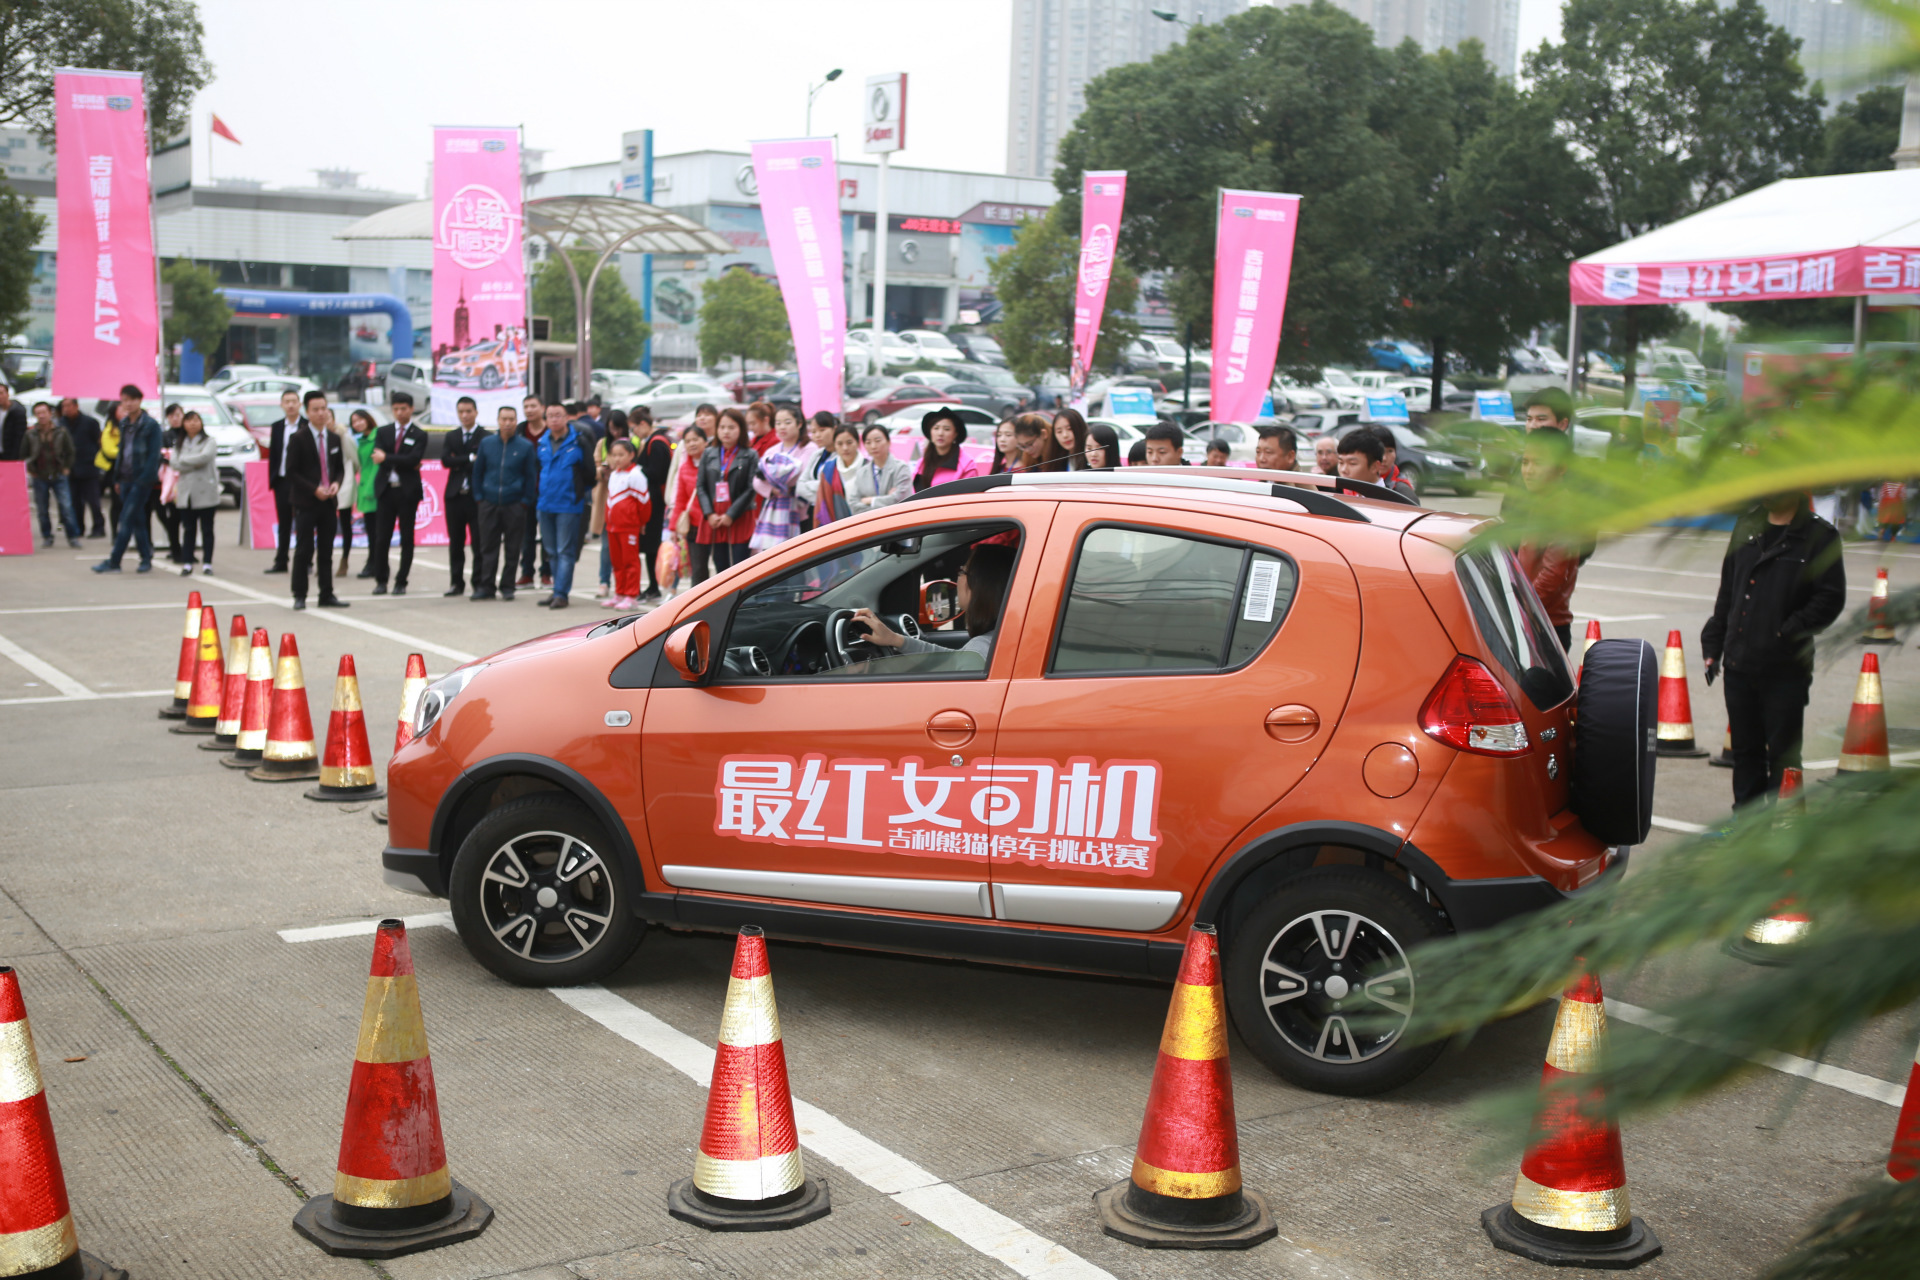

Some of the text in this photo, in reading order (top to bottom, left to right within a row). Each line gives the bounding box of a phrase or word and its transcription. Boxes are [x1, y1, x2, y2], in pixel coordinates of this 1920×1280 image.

[1659, 256, 1835, 299] 最红女司机
[718, 759, 1157, 848] 最红女司机
[888, 827, 1150, 870] 吉利熊猫停车挑战赛
